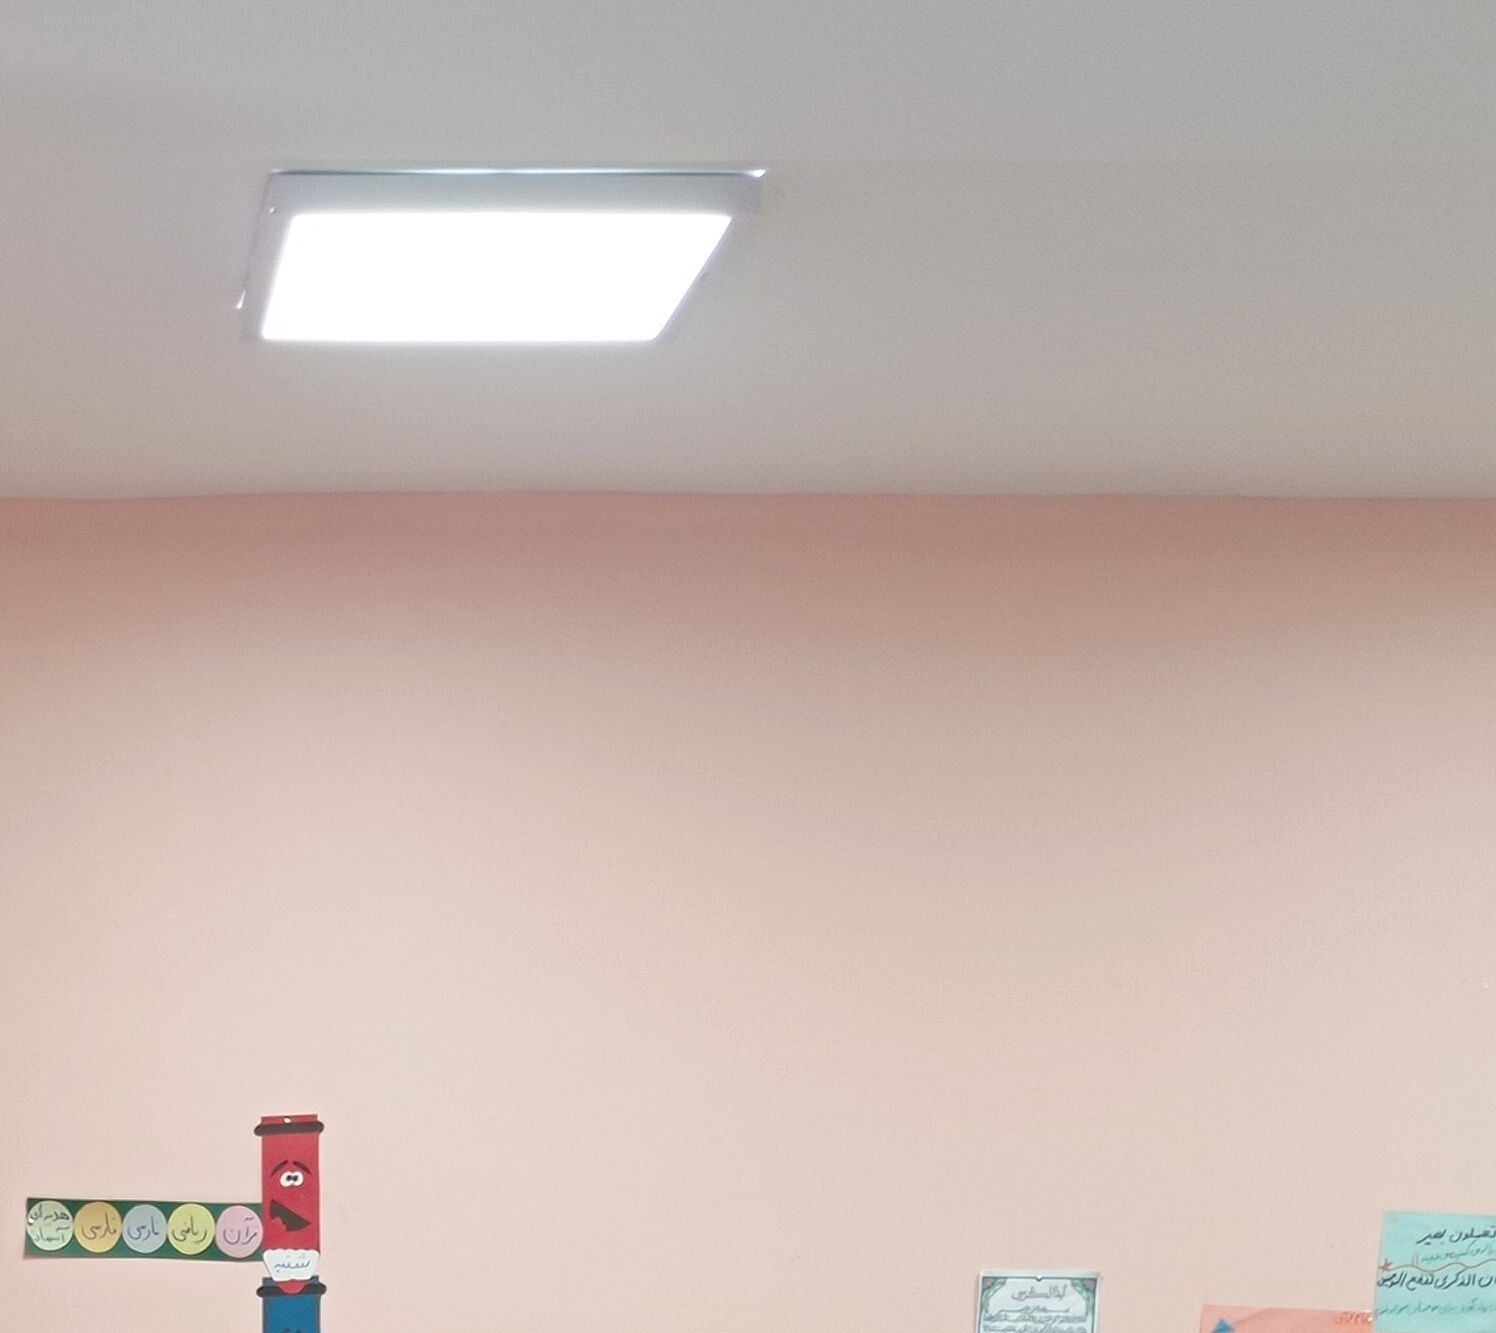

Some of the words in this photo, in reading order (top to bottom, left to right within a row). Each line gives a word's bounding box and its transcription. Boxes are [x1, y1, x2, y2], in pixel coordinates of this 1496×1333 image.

[80, 1212, 118, 1241] فارسی
[171, 1214, 209, 1244] ریاضی
[222, 1216, 258, 1246] قرآن
